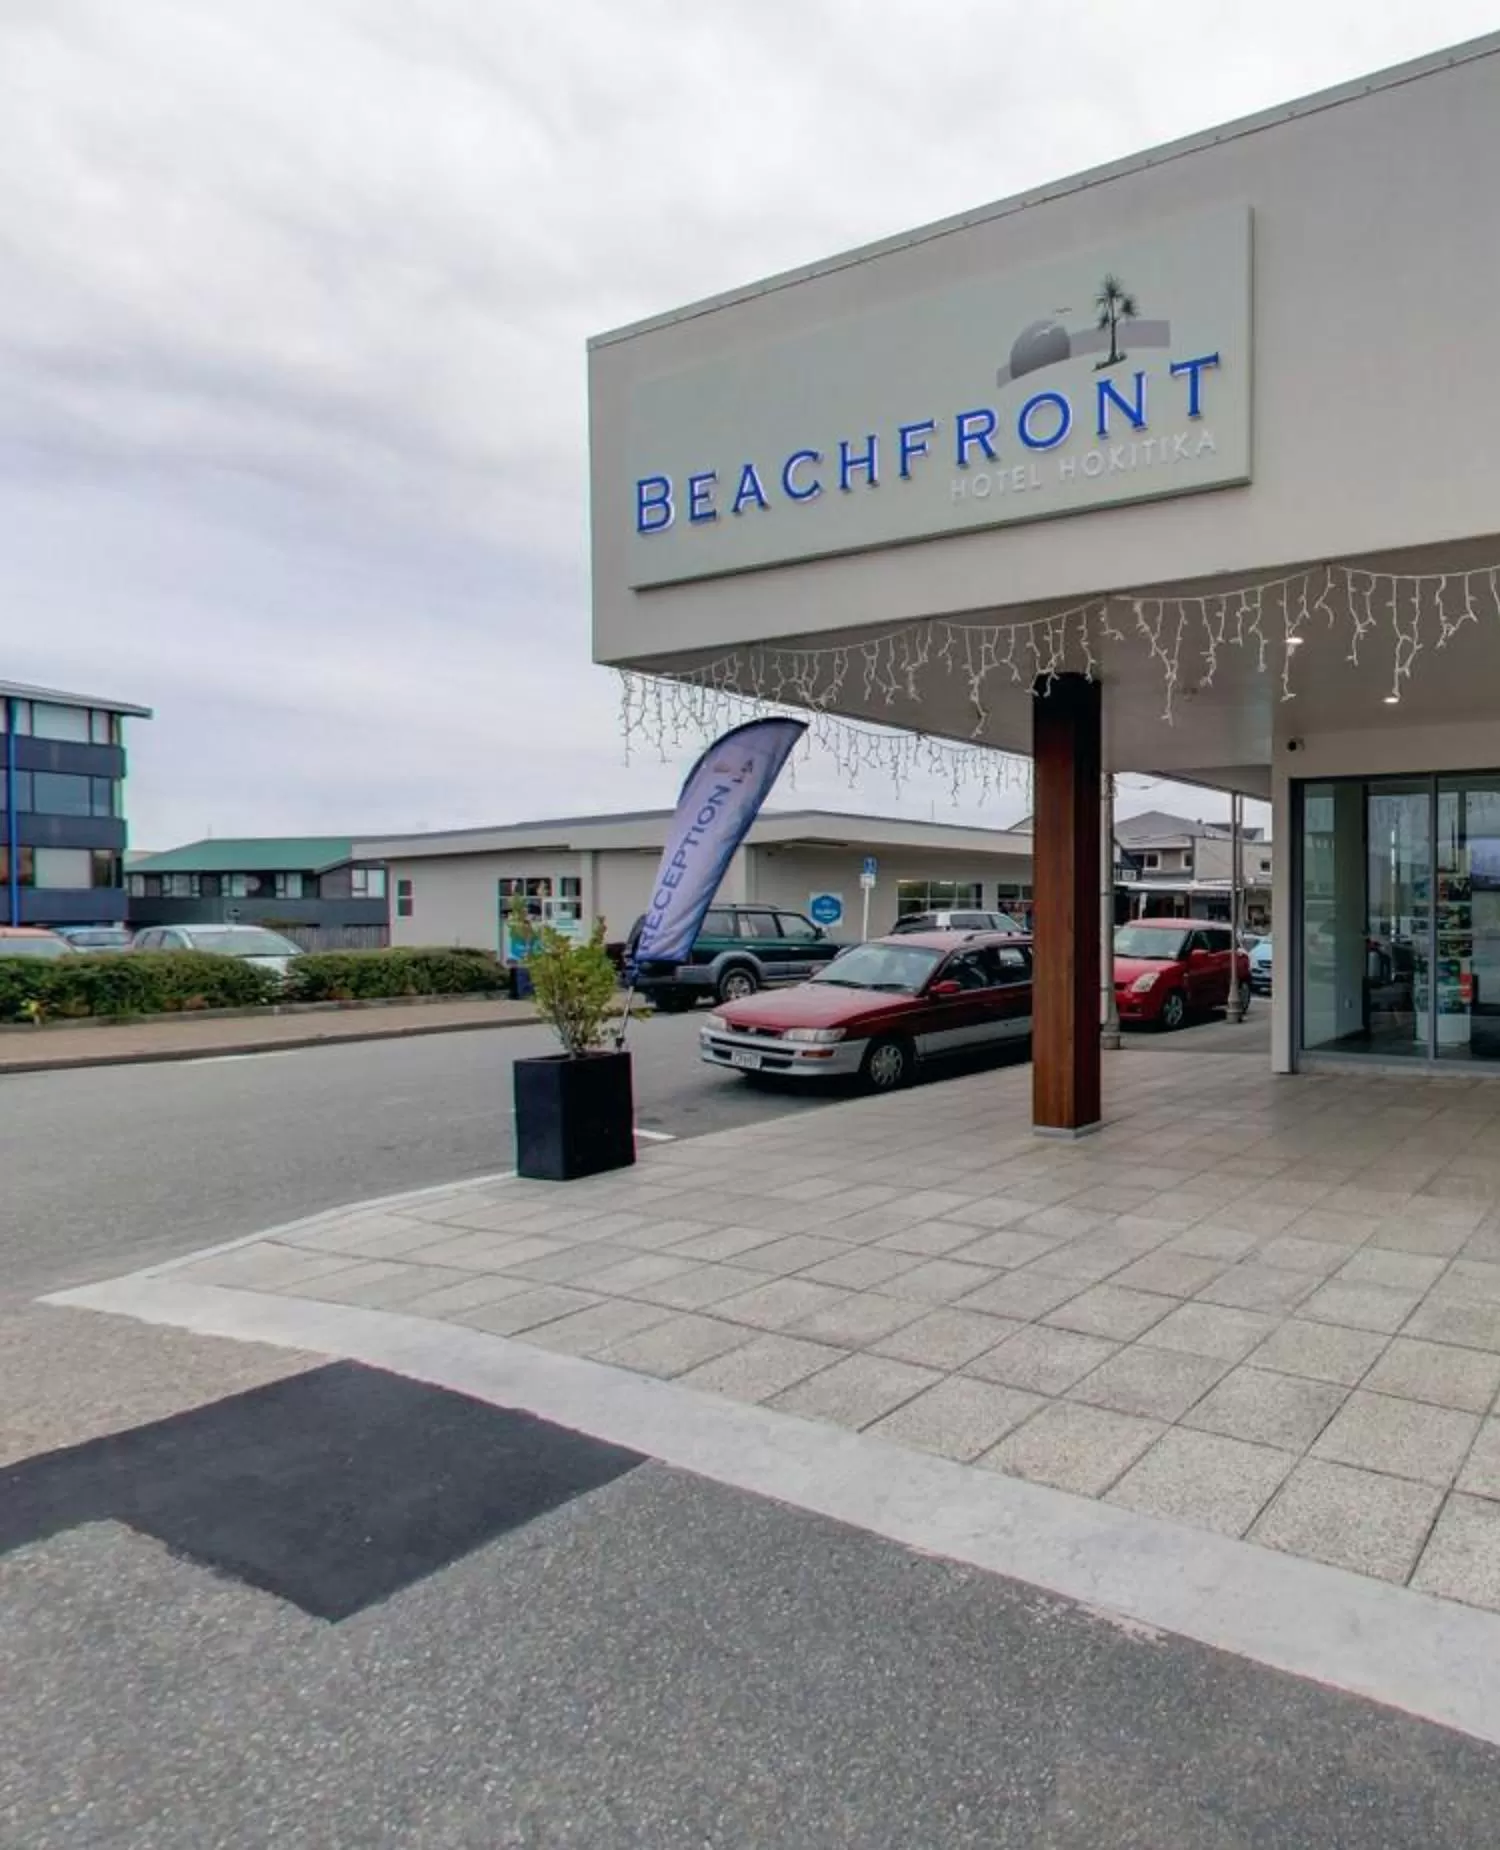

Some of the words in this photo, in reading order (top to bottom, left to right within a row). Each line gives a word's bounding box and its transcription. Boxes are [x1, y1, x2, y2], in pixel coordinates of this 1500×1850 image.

[636, 352, 1220, 533] BEACHFRONT
[951, 463, 1042, 499] HOTEL
[1059, 428, 1217, 481] HOKITIKA
[641, 784, 732, 950] RECEPTION
